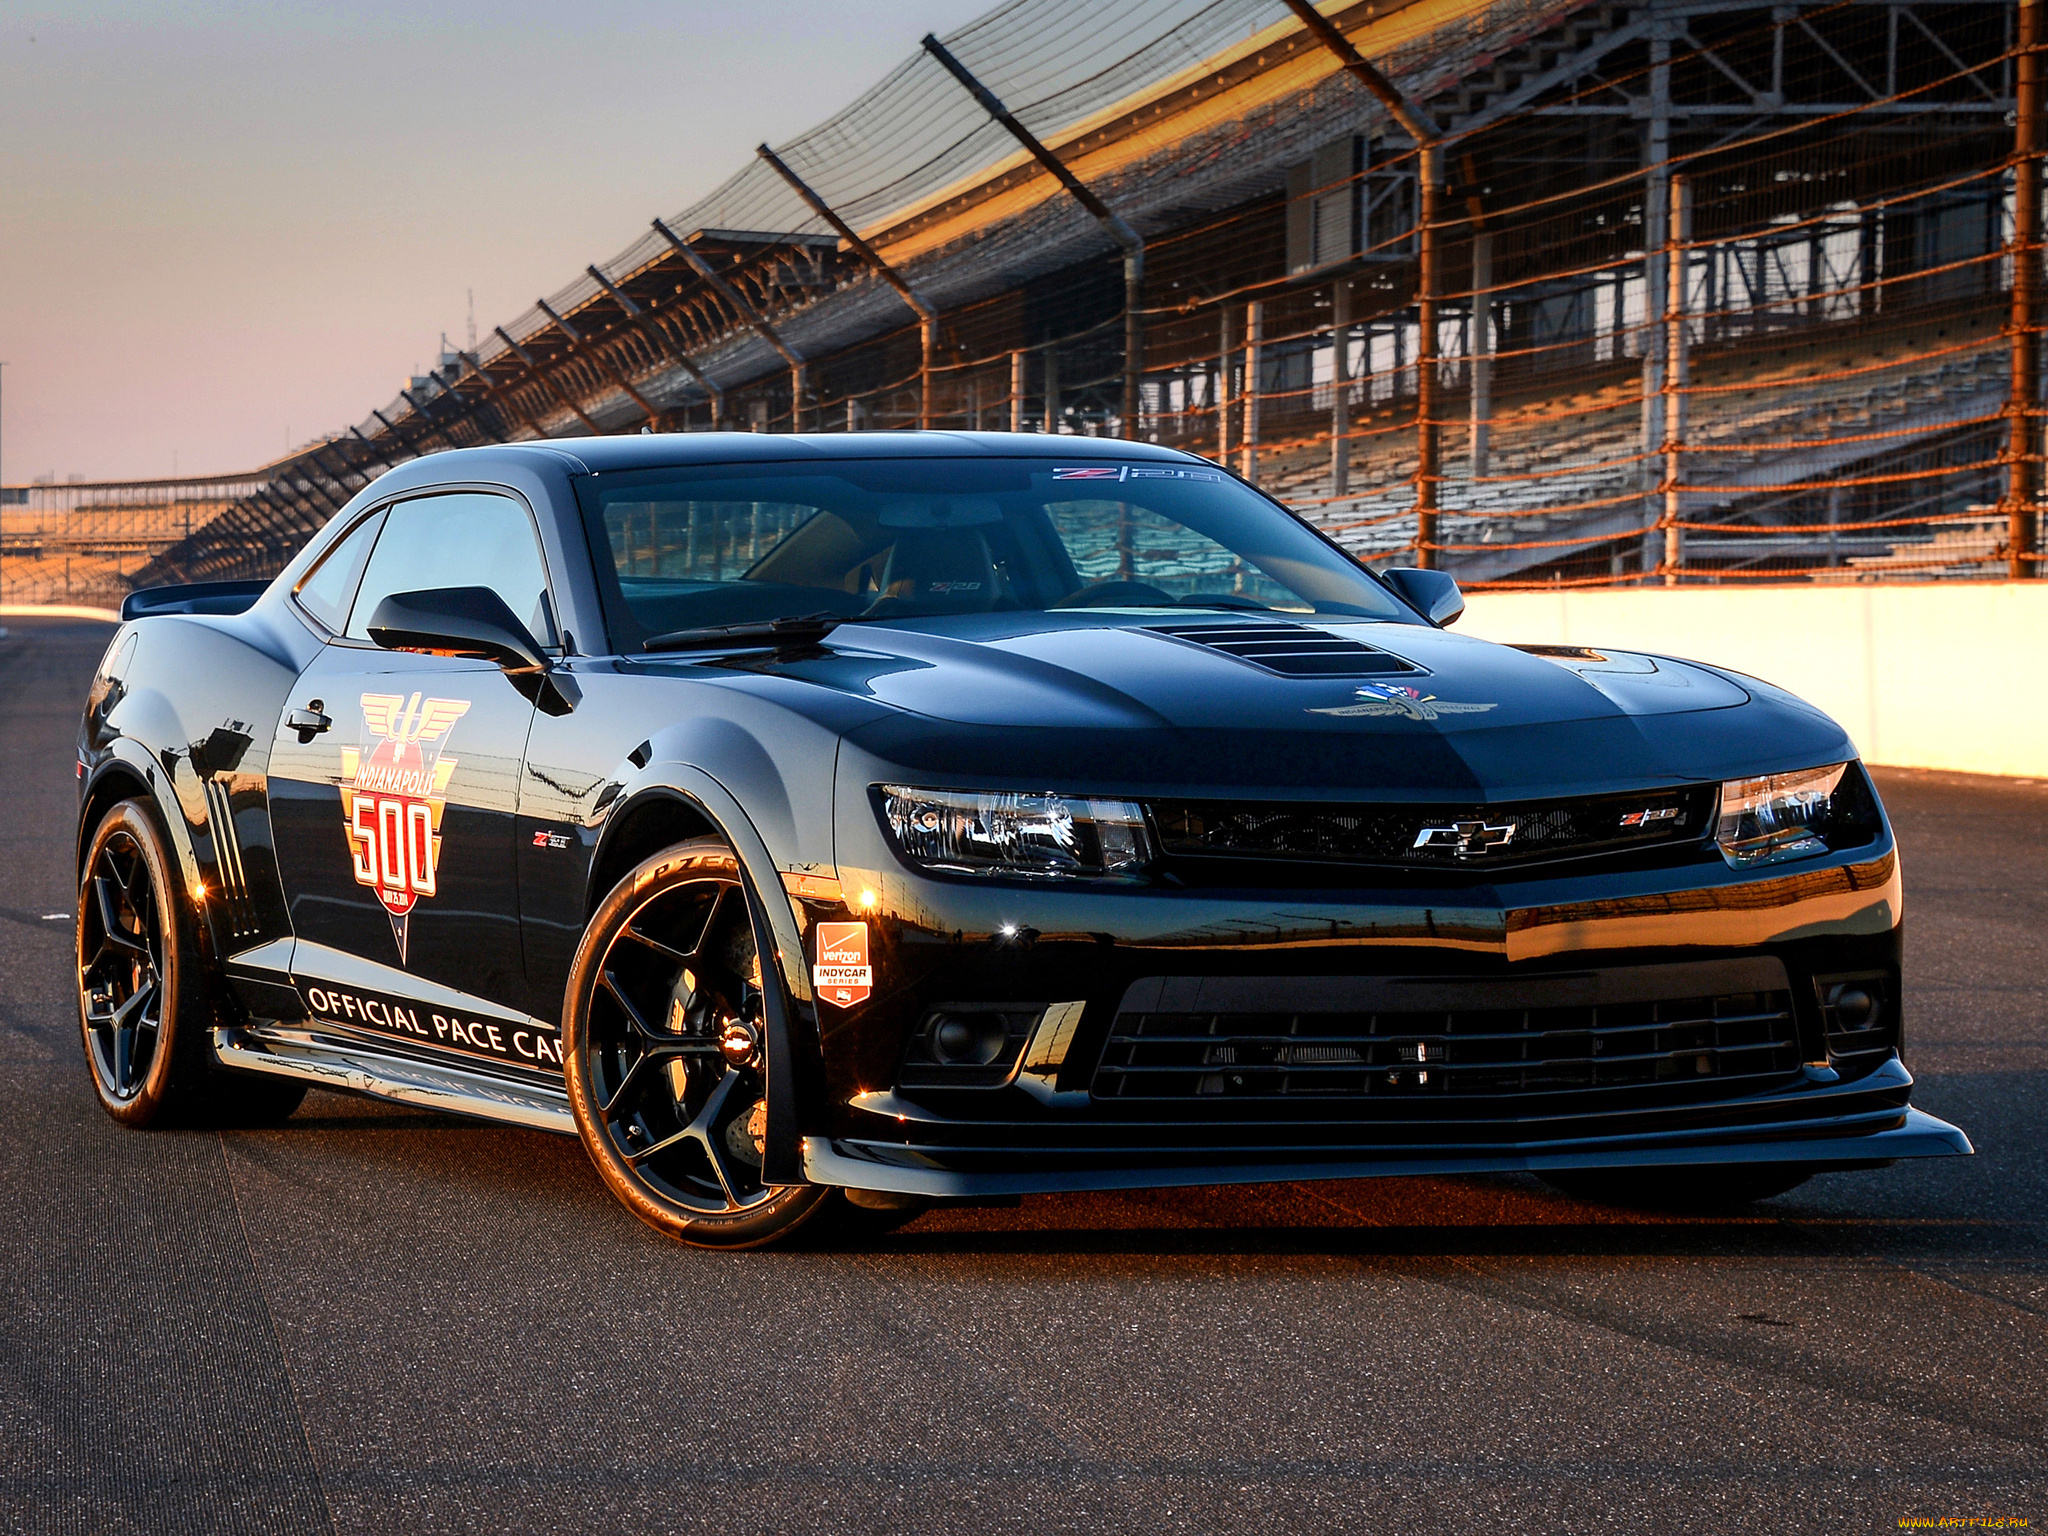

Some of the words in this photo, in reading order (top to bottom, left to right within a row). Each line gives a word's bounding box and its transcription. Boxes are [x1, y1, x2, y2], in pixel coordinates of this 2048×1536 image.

[354, 763, 436, 796] INDIANAPOLIS
[352, 795, 436, 896] 500
[653, 863, 669, 880] P
[823, 948, 861, 964] verizon
[819, 968, 867, 977] INDYCAR
[308, 987, 429, 1035] OFFICIAL
[431, 1013, 507, 1052] PACE
